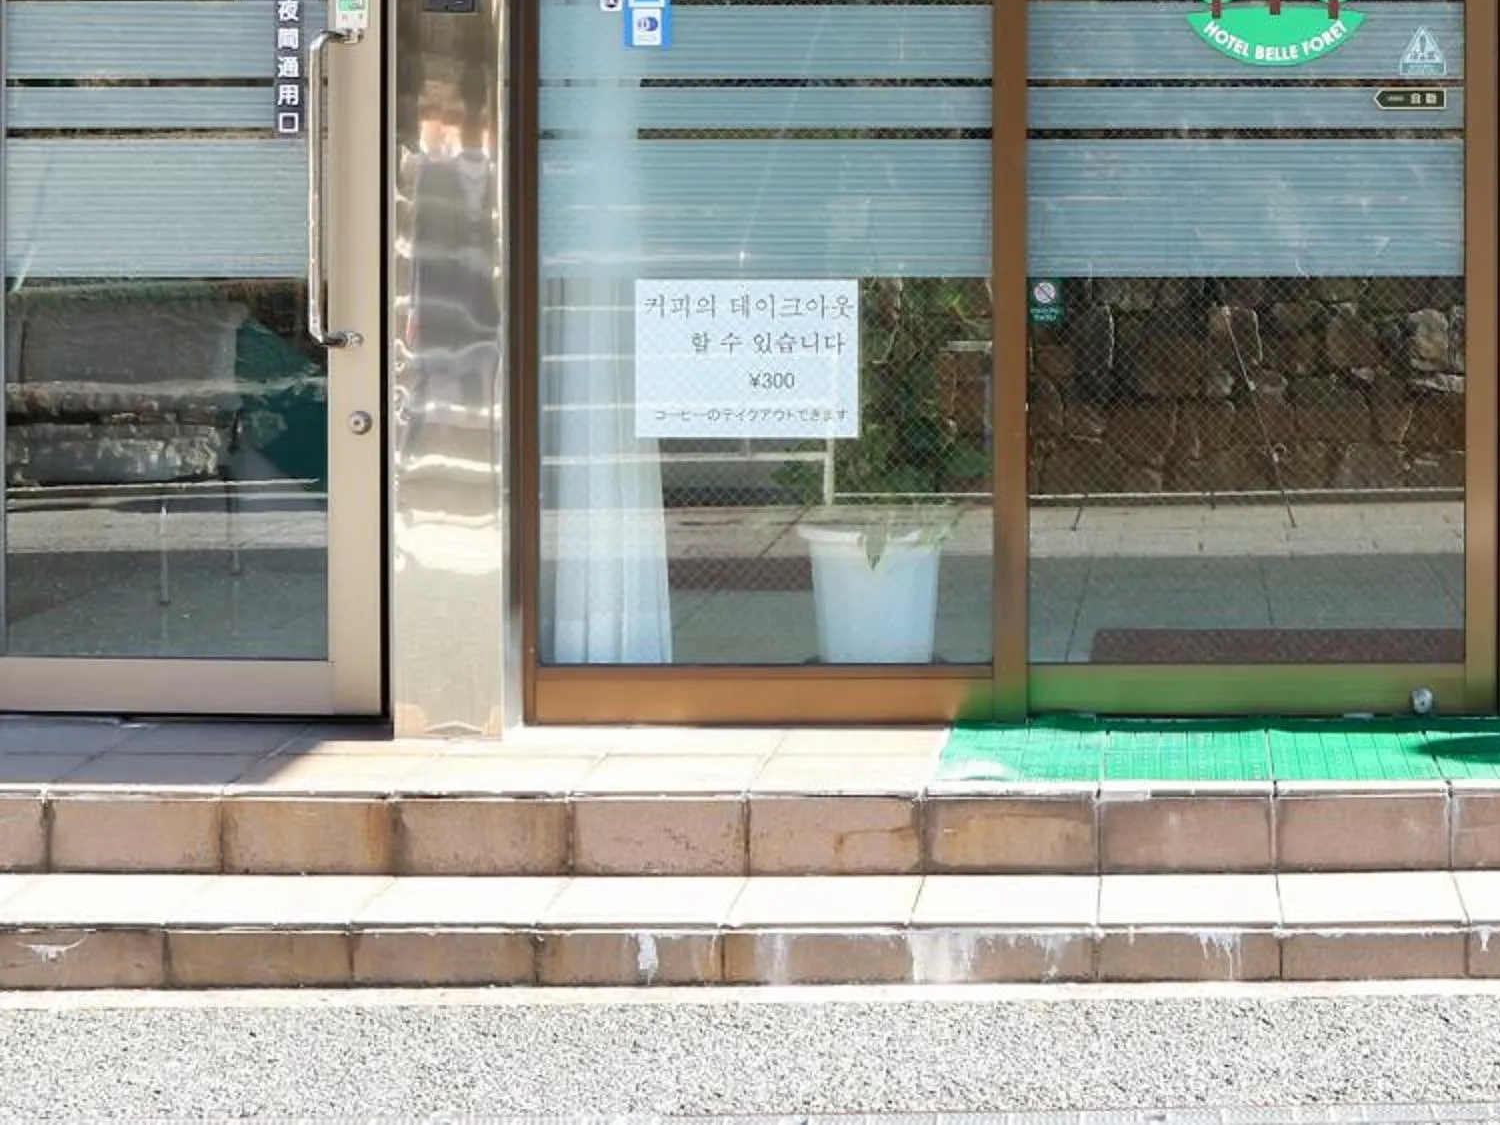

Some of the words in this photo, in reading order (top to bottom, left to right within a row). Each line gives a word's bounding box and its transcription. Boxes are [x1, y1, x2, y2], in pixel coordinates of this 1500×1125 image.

[1203, 20, 1250, 57] HOTEL
[1255, 44, 1299, 60] BELLE
[1301, 19, 1348, 55] FORET
[643, 293, 716, 319] 커피의
[730, 293, 855, 320] 테이크아웃
[691, 331, 712, 354] 할
[720, 332, 743, 355] 수
[753, 331, 846, 355] 있습니다
[749, 373, 796, 389] ¥300
